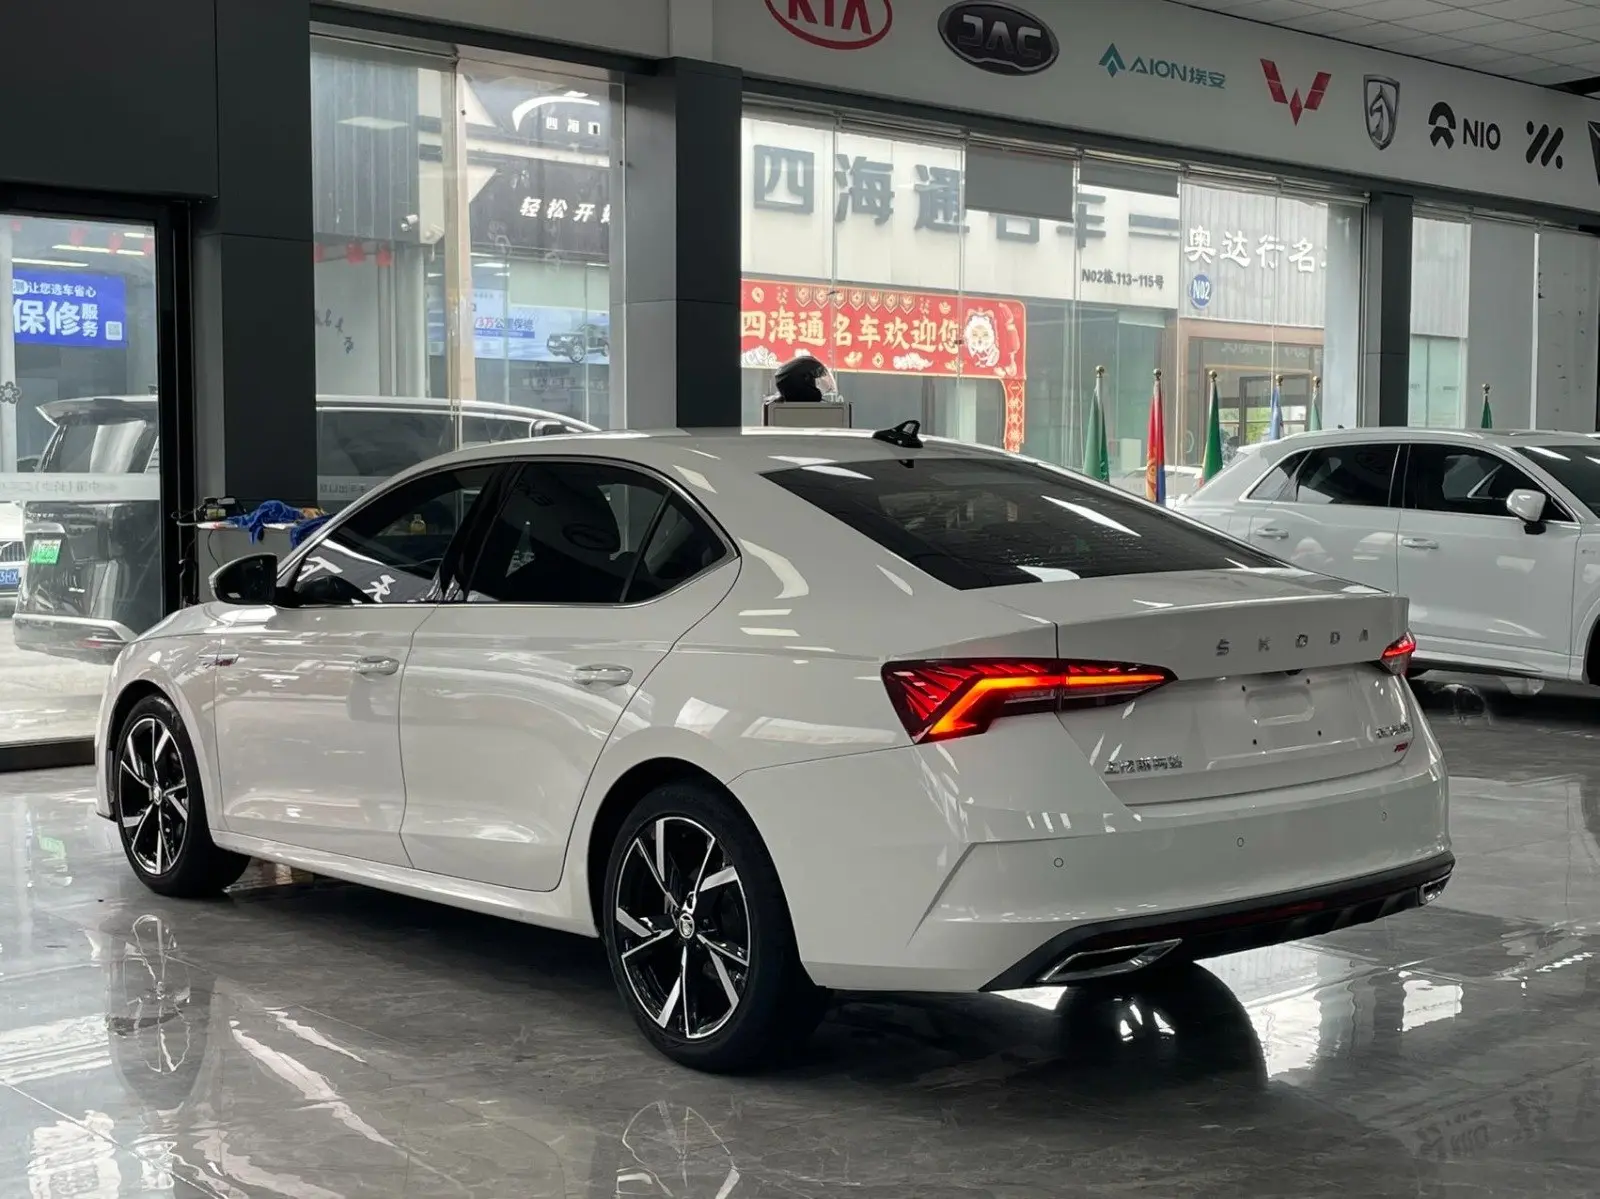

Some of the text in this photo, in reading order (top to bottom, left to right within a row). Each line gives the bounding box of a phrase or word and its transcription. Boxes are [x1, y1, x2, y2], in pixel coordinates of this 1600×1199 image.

[1129, 56, 1226, 89] AION 埃安
[1463, 118, 1501, 150] NIO
[1184, 225, 1327, 273] 奥达行名
[740, 306, 960, 354] 四海通名车欢迎您
